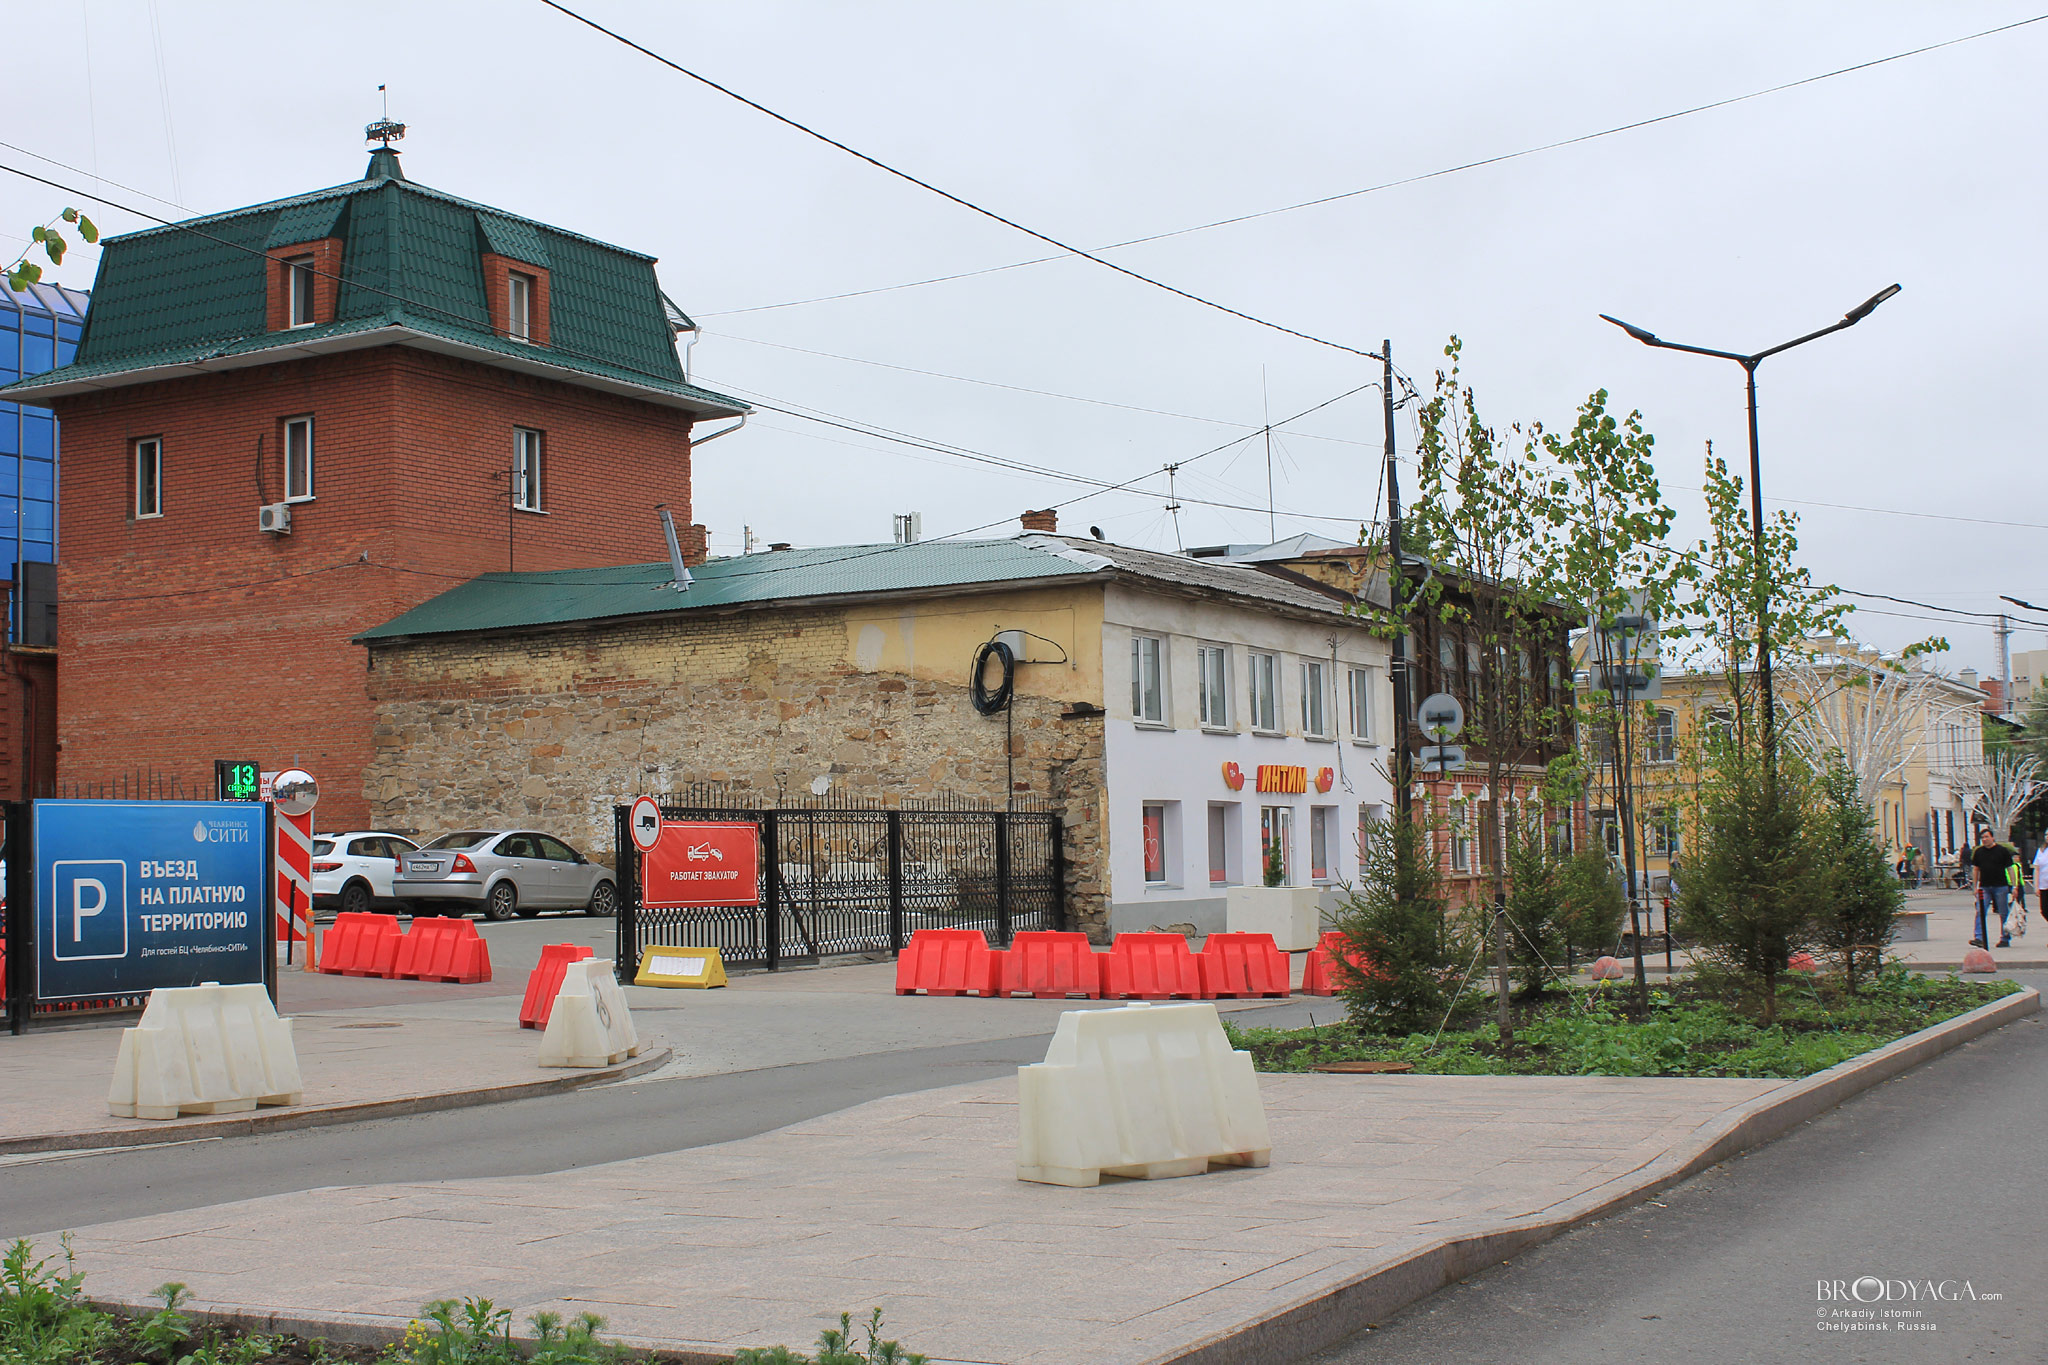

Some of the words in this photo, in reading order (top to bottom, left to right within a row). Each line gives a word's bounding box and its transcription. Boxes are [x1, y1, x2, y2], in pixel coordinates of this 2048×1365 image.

[231, 765, 254, 785] 13
[1260, 765, 1307, 793] ИНТИМ
[208, 828, 249, 843] СИТИ
[141, 860, 198, 880] ВЪЕЗД
[670, 871, 703, 881] РАБОТАЕТ
[703, 870, 739, 880] ЭВАКУАТОР
[141, 887, 165, 905] НА
[169, 885, 245, 904] ПЛАТНУЮ
[141, 911, 247, 932] ТЕРРИТОРИЮ
[141, 948, 155, 957] Для
[156, 946, 177, 956] гостей
[179, 946, 189, 956] БЦ
